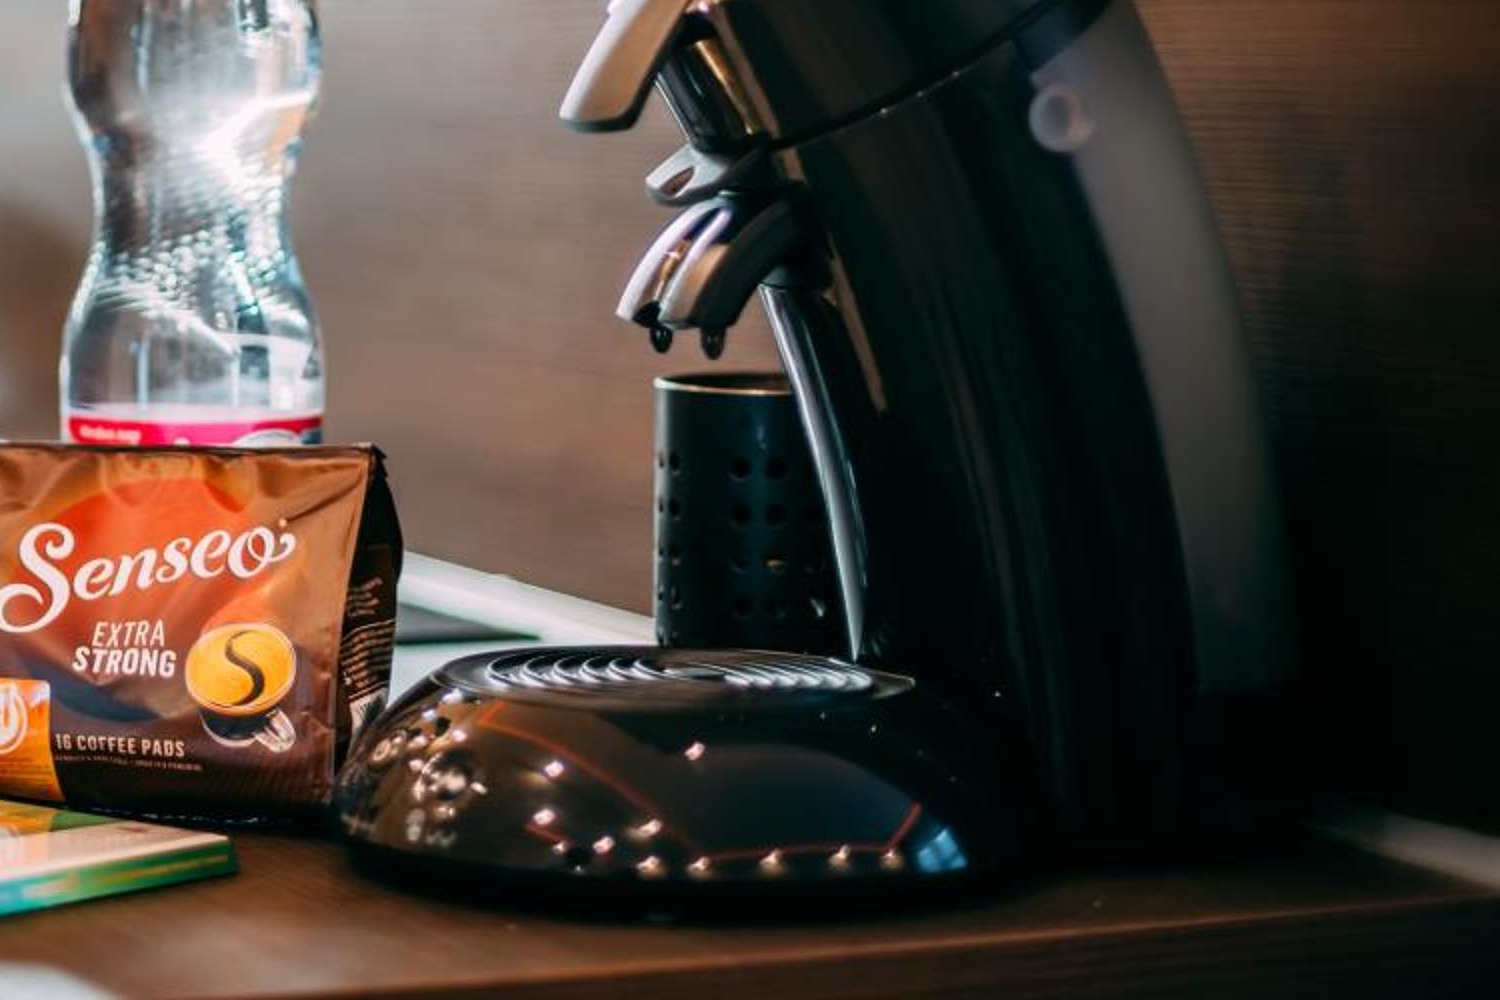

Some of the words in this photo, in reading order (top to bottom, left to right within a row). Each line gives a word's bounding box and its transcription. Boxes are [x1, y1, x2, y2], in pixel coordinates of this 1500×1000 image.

[92, 619, 165, 647] EXTRA
[72, 646, 177, 678] STRONG
[76, 734, 138, 755] COFFEE
[141, 739, 186, 758] PADS
